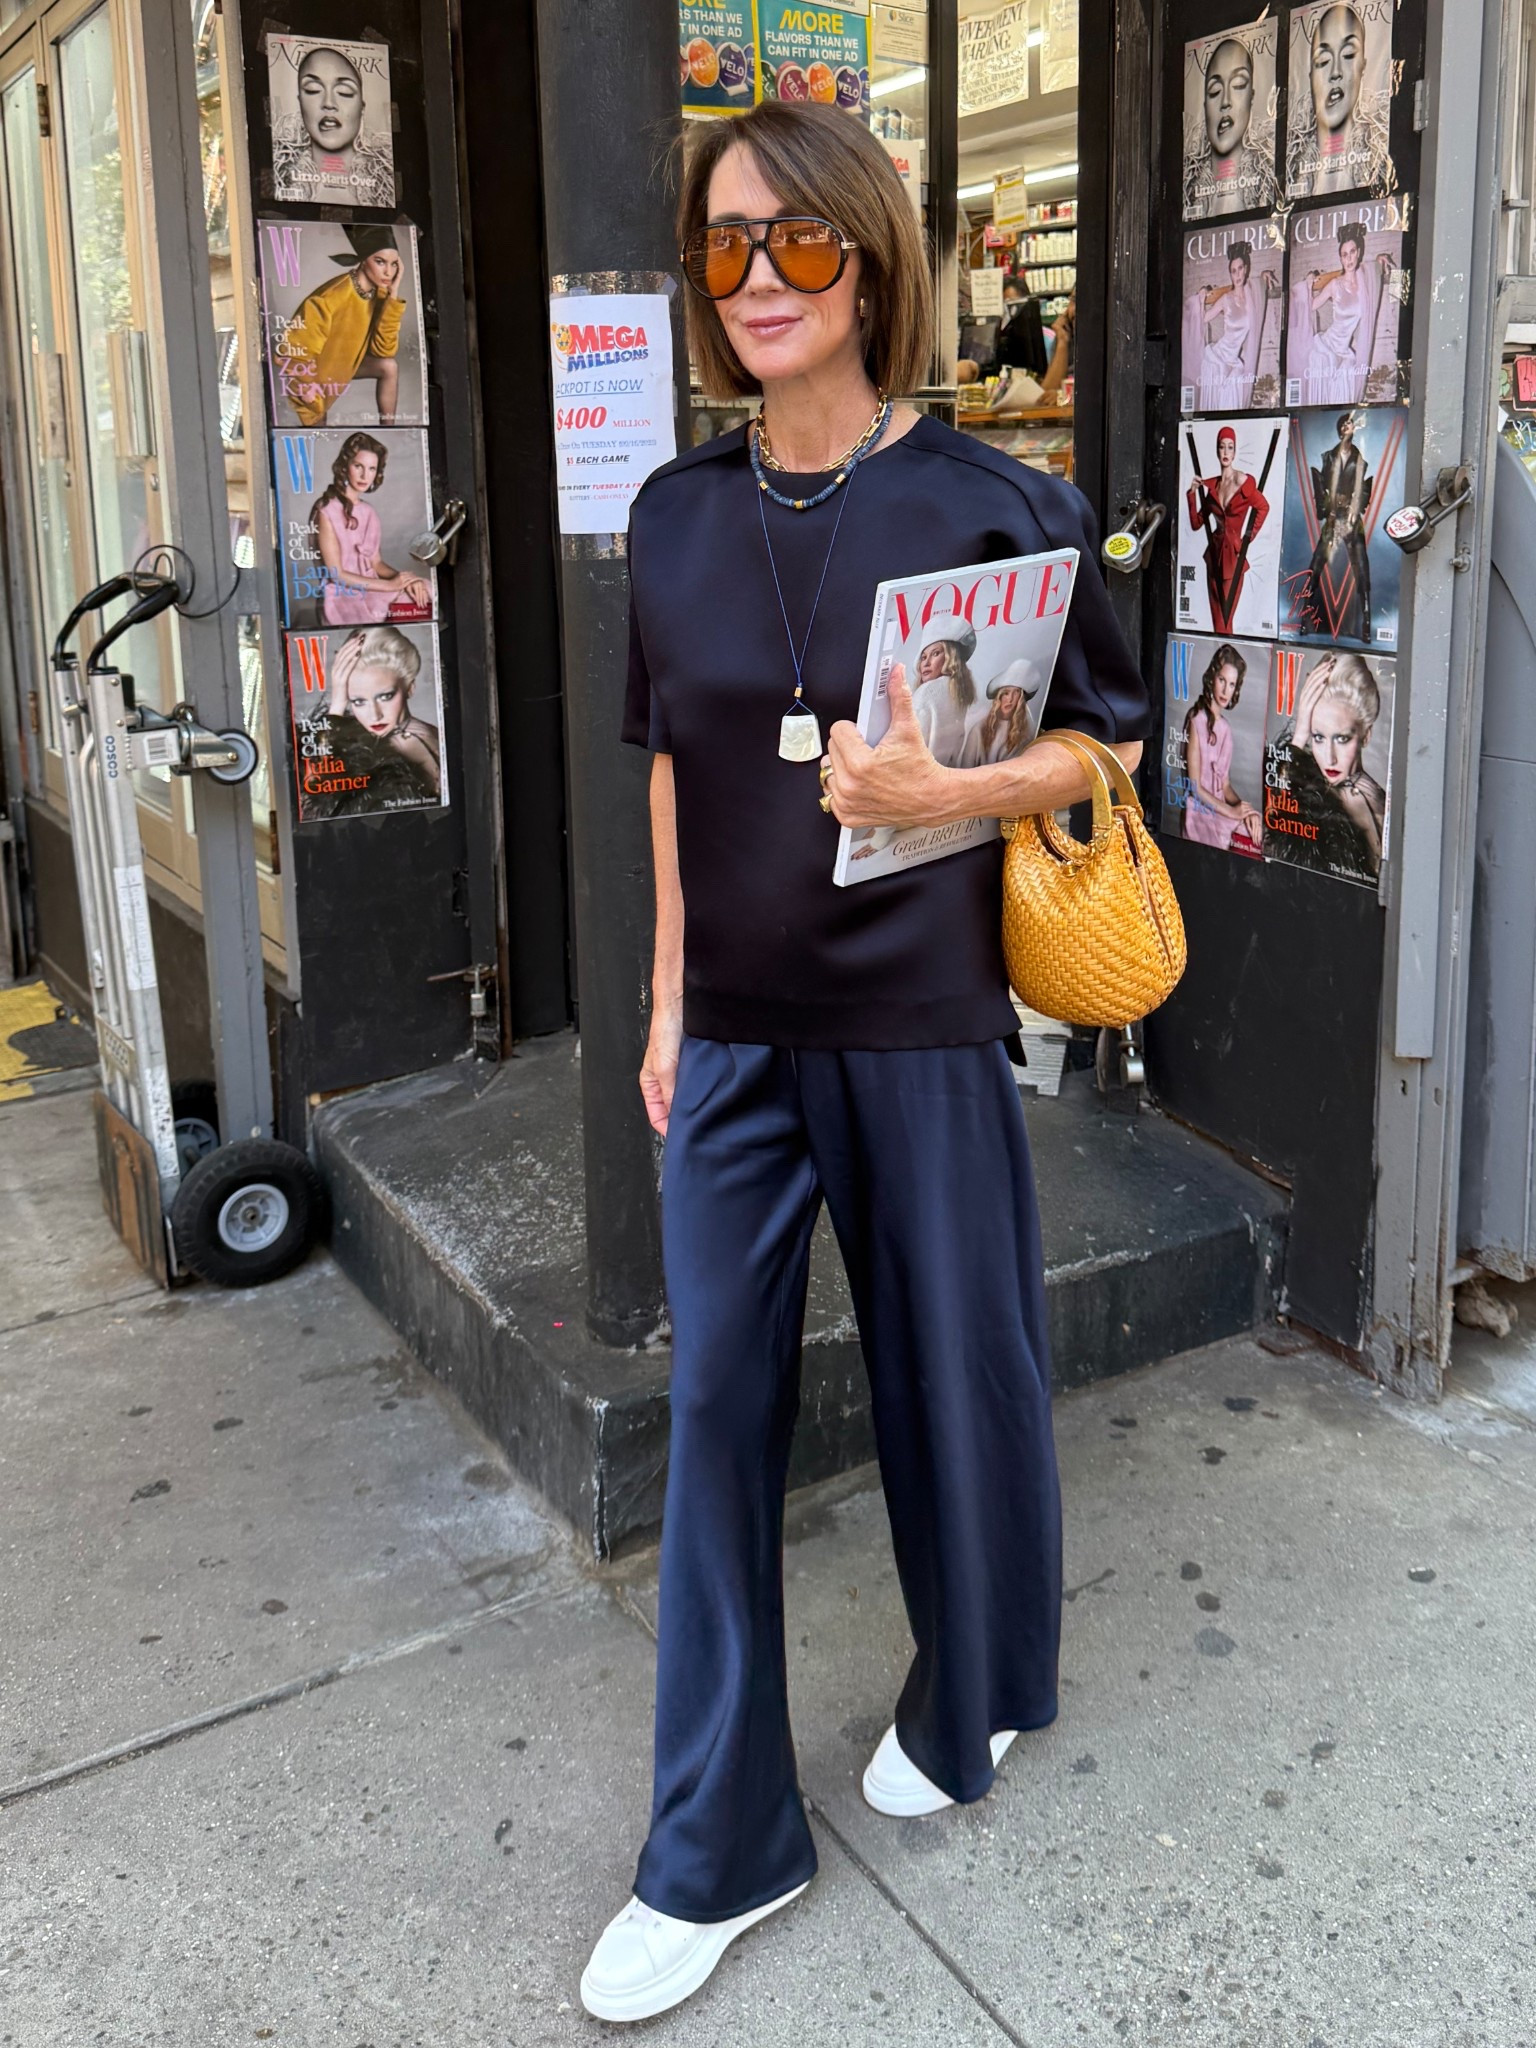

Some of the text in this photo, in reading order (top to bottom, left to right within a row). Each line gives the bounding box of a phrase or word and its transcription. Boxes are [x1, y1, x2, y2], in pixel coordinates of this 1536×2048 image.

[693, 10, 724, 23] THAN
[725, 12, 743, 25] WE
[779, 9, 845, 36] MORE
[688, 23, 700, 35] IN
[702, 25, 726, 37] ONE
[727, 27, 743, 38] AD
[765, 31, 859, 49] FLAVORS THAN WE
[767, 45, 858, 63] CAN FIT IN ONE AD
[720, 57, 745, 76] VELO
[761, 74, 776, 99] ELO
[785, 74, 805, 100] VELO
[812, 76, 833, 93] VELO
[837, 81, 859, 98] VELO
[1299, 160, 1322, 174] Lizzo
[1321, 155, 1347, 170] Starts
[1347, 150, 1372, 165] Over
[291, 170, 321, 182] Lizzo
[320, 171, 349, 185] Starts
[349, 174, 377, 188] Over
[1194, 184, 1216, 198] Lizzo
[1215, 179, 1238, 193] Starts
[1238, 175, 1261, 189] Over
[266, 226, 303, 287] W
[275, 316, 307, 331] Peak
[274, 330, 291, 343] of
[568, 324, 648, 355] MEGA
[275, 342, 308, 357] Chic
[567, 348, 649, 374] MILLIONS
[279, 376, 351, 399] Kravitz
[593, 380, 604, 393] IS
[607, 379, 644, 392] NOW
[557, 405, 651, 431] $400 MILLION
[581, 441, 618, 449] TUESDAY
[281, 435, 318, 494] W
[575, 456, 600, 464] EACH
[601, 454, 631, 463] GAME
[288, 521, 320, 535] Peak
[288, 534, 303, 548] of
[289, 548, 322, 561] Chic
[291, 561, 339, 581] Lana
[292, 579, 327, 601] Del
[894, 560, 1073, 646] VOGUE
[294, 635, 329, 693] W
[1171, 640, 1195, 702] W
[1277, 650, 1305, 717] W
[301, 717, 333, 733] Peak
[1168, 726, 1190, 744] Peak
[301, 731, 317, 746] of
[1167, 740, 1178, 754] of
[105, 735, 119, 779] COSCO
[301, 743, 334, 757] Chic
[1267, 743, 1293, 763] Peak
[303, 756, 346, 777] Julia
[1166, 752, 1188, 771] Chic
[1265, 758, 1279, 774] of
[303, 774, 371, 795] Garner
[1166, 767, 1198, 792] Lana
[1265, 771, 1292, 791] Chic
[383, 796, 438, 808] The Fashion Issue
[1264, 786, 1300, 815] Julia
[1264, 808, 1320, 842] Garner
[892, 831, 929, 857] Great
[901, 847, 935, 862] TRADITION
[1328, 860, 1379, 885] The Fashion Issue
